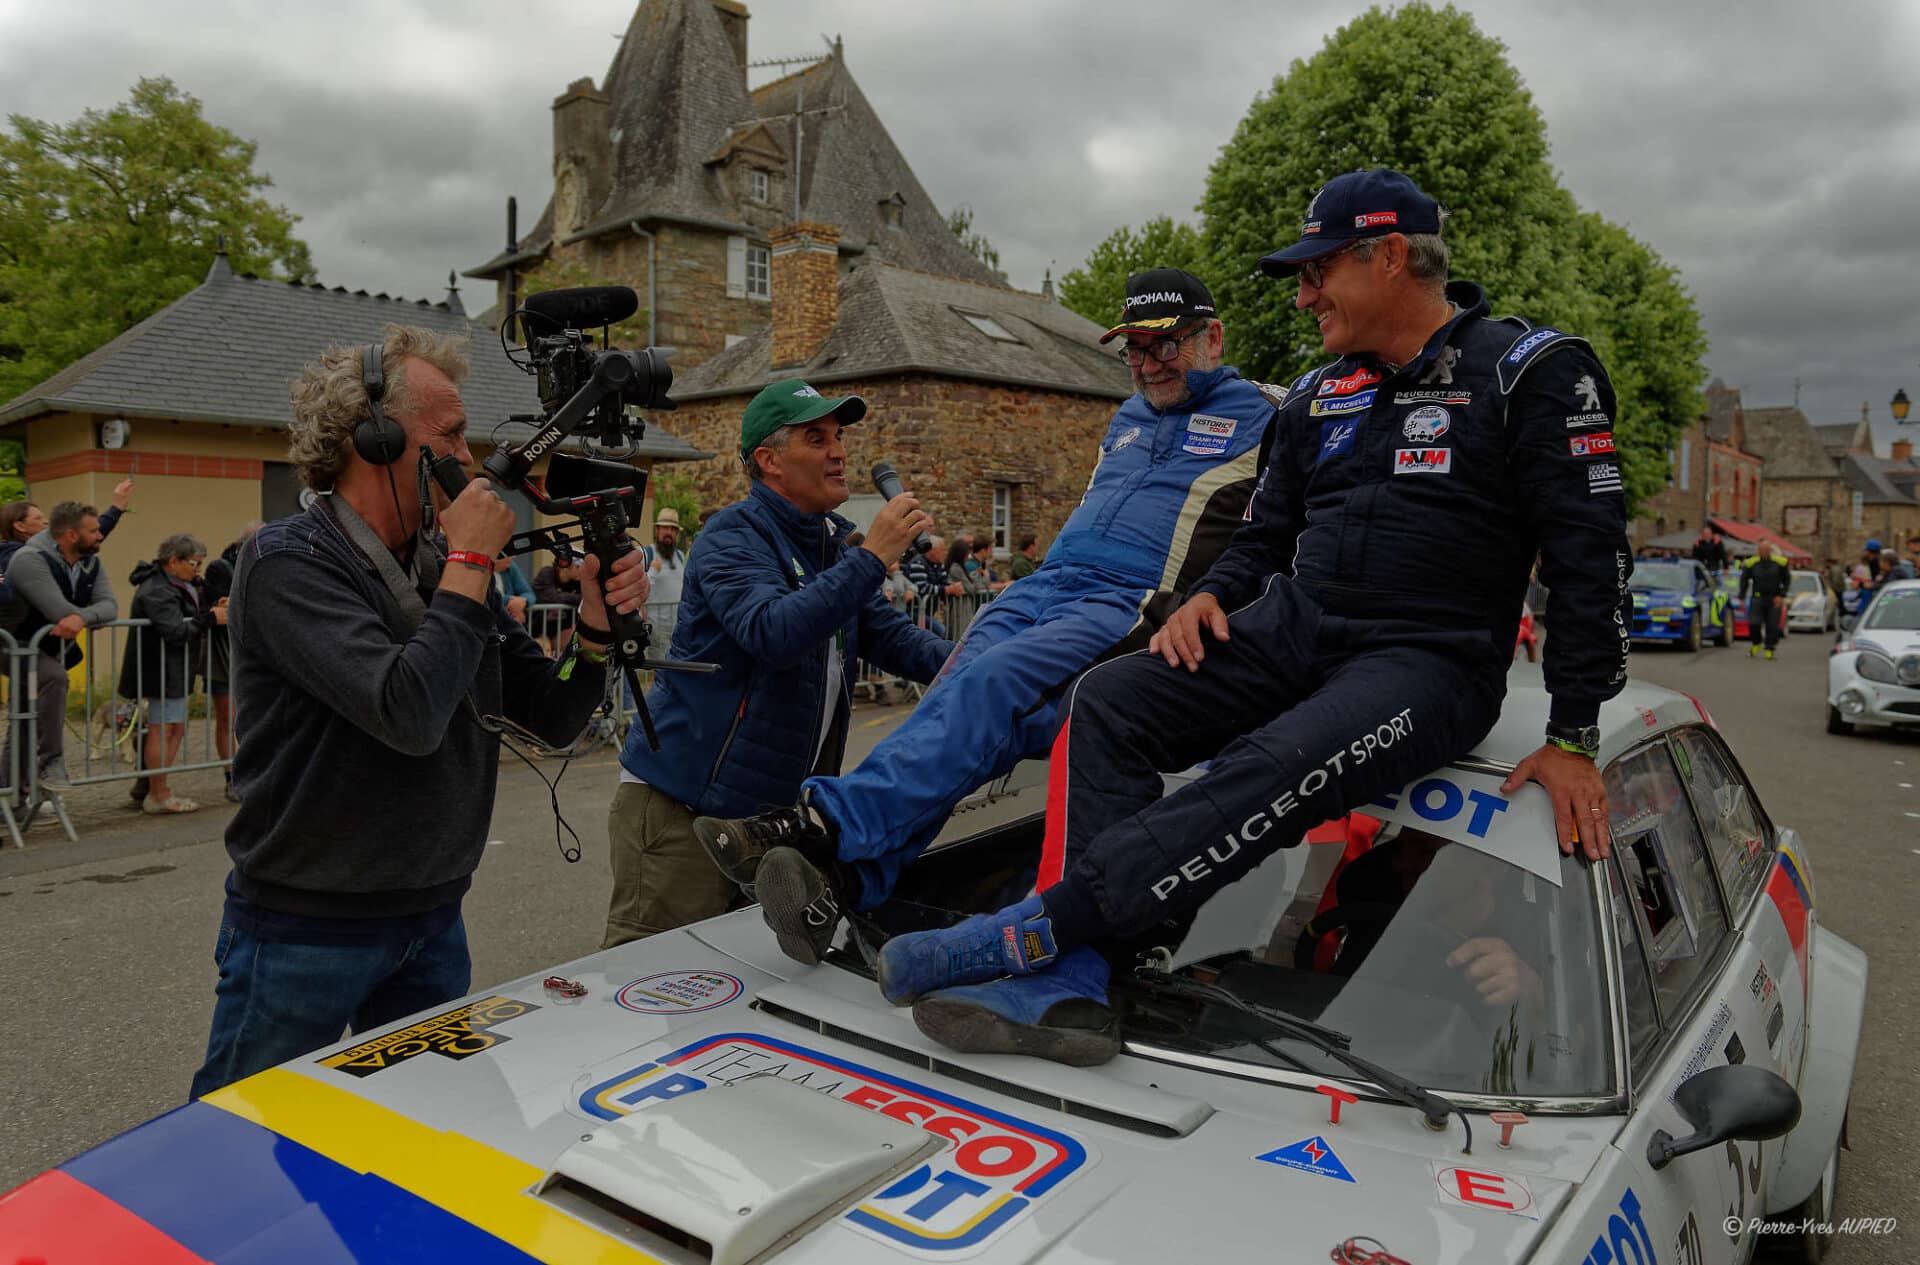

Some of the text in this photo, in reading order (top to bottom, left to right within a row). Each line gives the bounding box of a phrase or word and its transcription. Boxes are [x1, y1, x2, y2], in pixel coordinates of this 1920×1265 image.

[1367, 215, 1397, 223] TOTAL
[1510, 330, 1560, 362] sparco
[1330, 395, 1371, 410] MICHELIN
[1395, 390, 1473, 398] PEUGEOT SPORT
[1192, 417, 1230, 429] HISTORIC
[1209, 426, 1229, 434] TOUR
[523, 426, 562, 462] RONIN
[1398, 450, 1447, 465] HVM
[1151, 708, 1417, 902] PEUGEOT SPORT
[343, 1027, 420, 1058] timing
[346, 1004, 526, 1068] OMEGA
[1453, 1168, 1515, 1210] E
